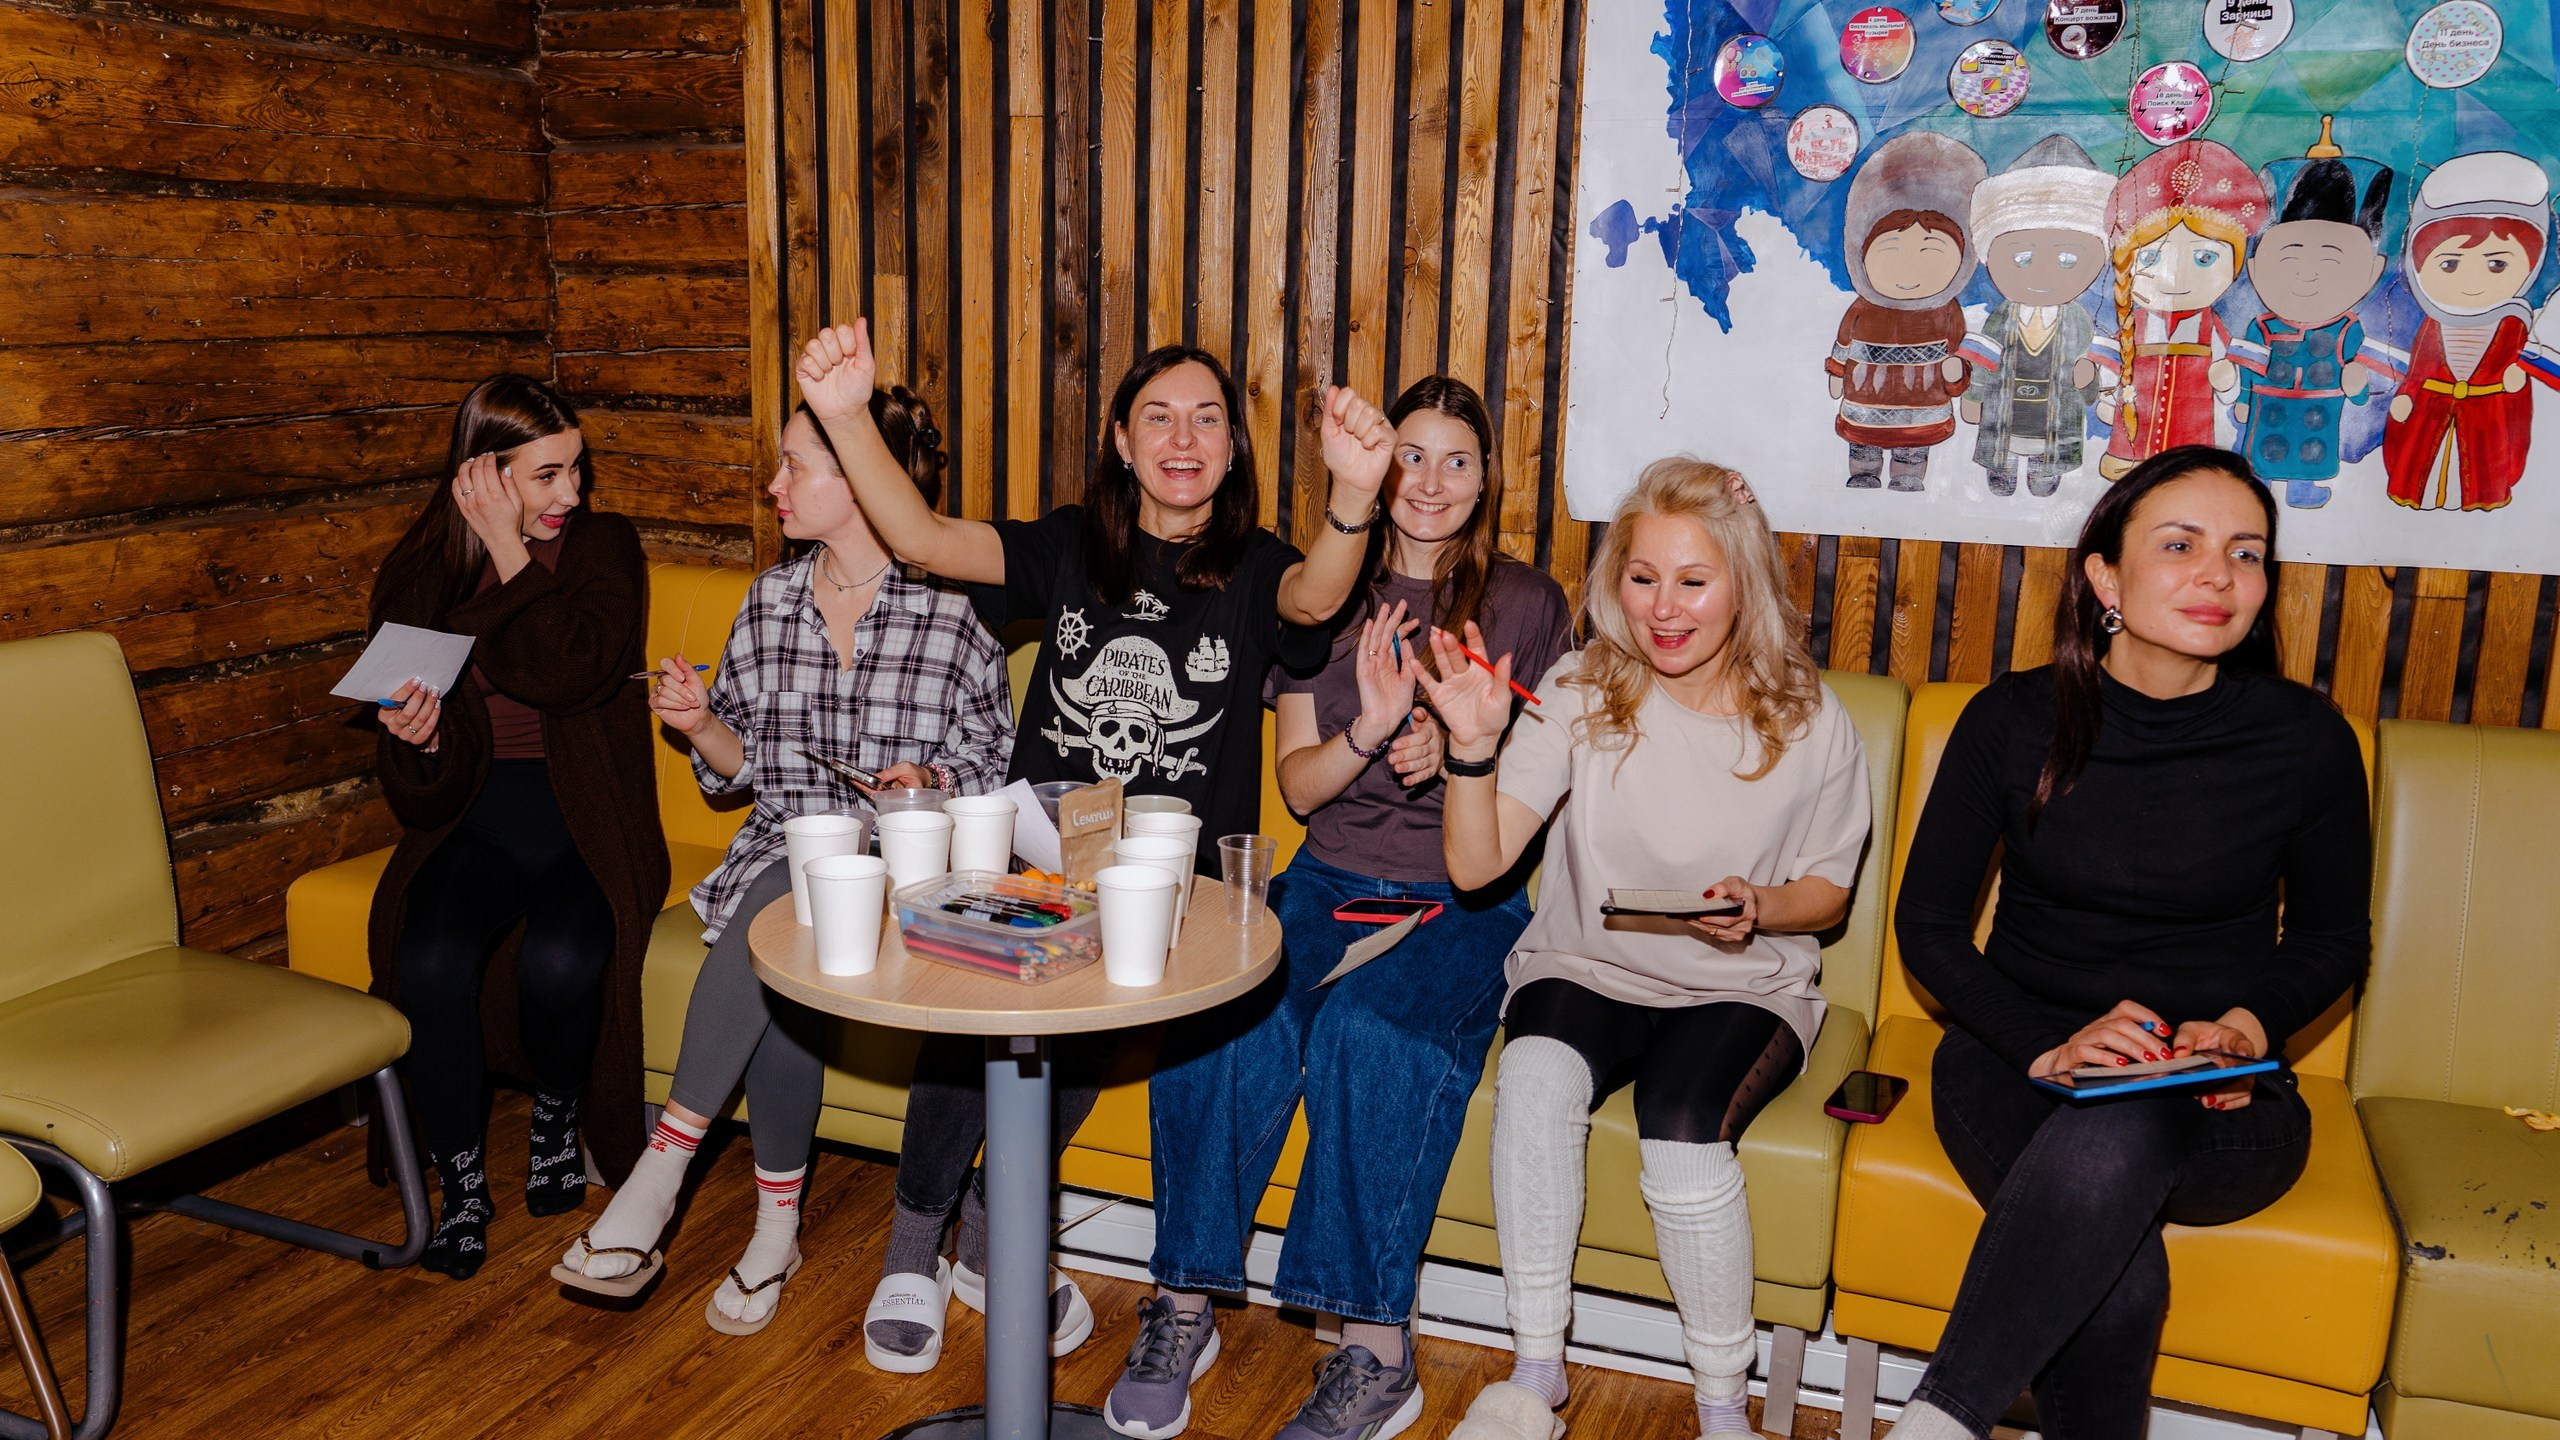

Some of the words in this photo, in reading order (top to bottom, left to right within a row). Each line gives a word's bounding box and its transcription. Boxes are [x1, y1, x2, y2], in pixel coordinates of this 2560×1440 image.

[2221, 9, 2271, 21] Зарница
[2421, 40, 2447, 49] День
[2449, 39, 2490, 47] бизнеса
[1103, 648, 1166, 676] PIRATES
[1131, 671, 1146, 680] THE
[1086, 675, 1172, 714] CARIBBEAN
[531, 1148, 577, 1172] Barbie
[881, 1298, 926, 1307] ESSENTIAL
